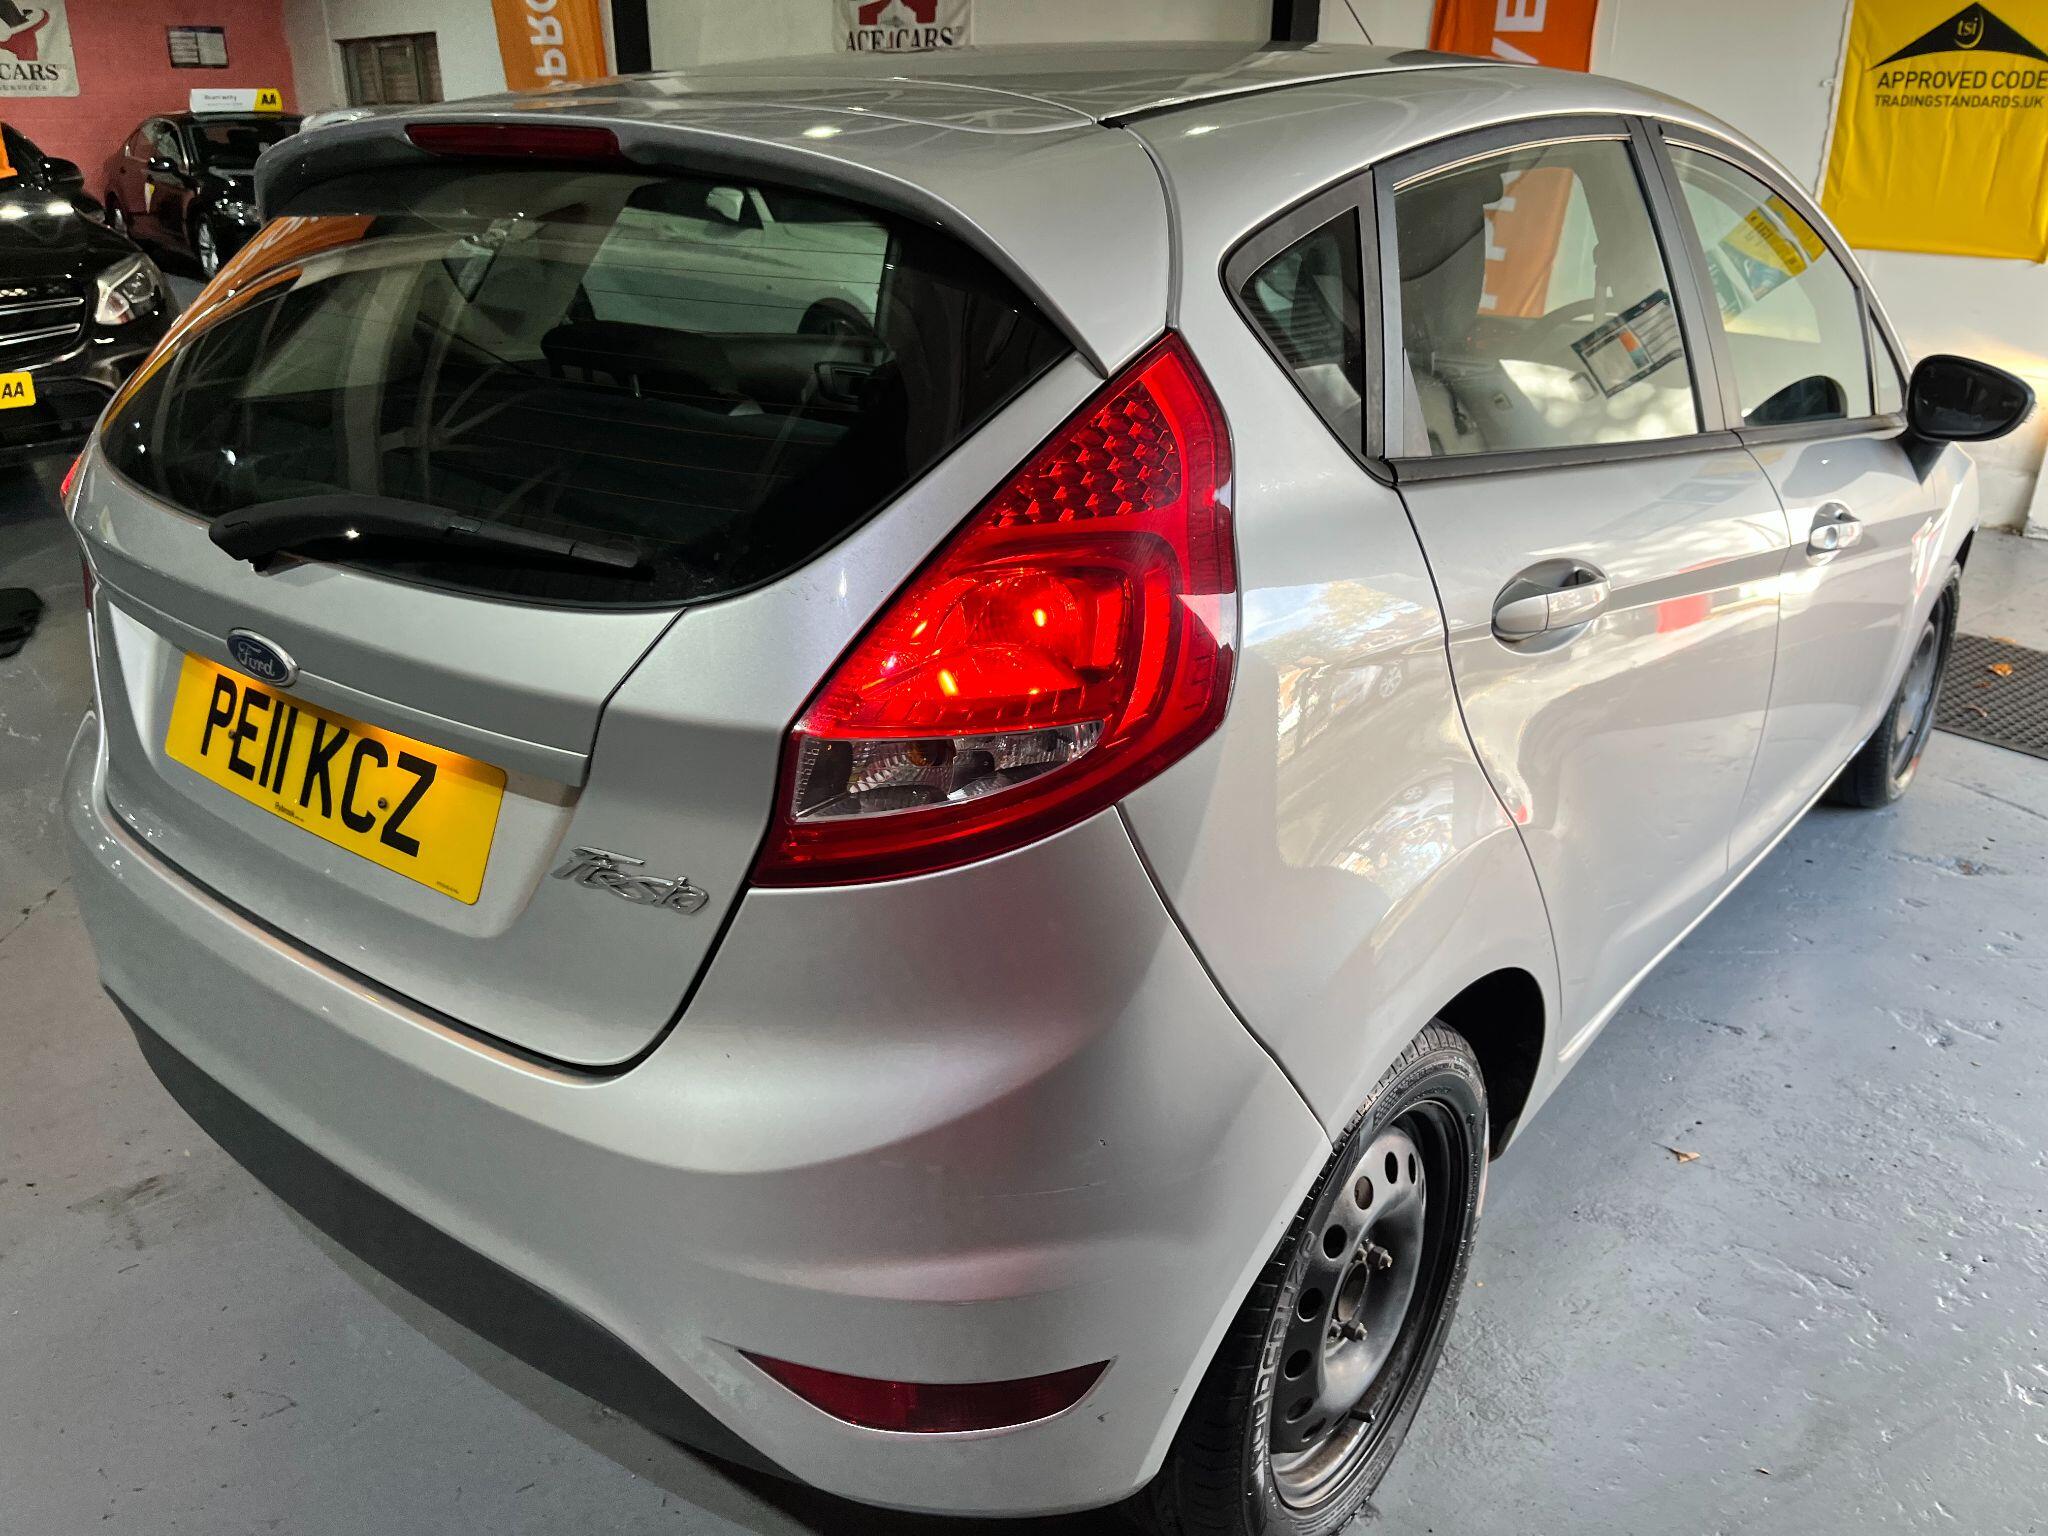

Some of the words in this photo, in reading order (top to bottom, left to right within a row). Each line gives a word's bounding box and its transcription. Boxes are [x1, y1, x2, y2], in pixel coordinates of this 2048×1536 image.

[1957, 17, 1979, 36] tsi
[0, 63, 59, 81] CARS
[1877, 71, 1986, 89] APPROVED
[1991, 71, 2048, 89] CODE
[1875, 95, 2044, 108] TRADINGSTANDARDS.UK
[2, 381, 25, 399] AA
[238, 641, 275, 677] Ford
[200, 673, 299, 794] PE11
[299, 718, 438, 857] KCZ
[551, 846, 709, 915] Fiesta
